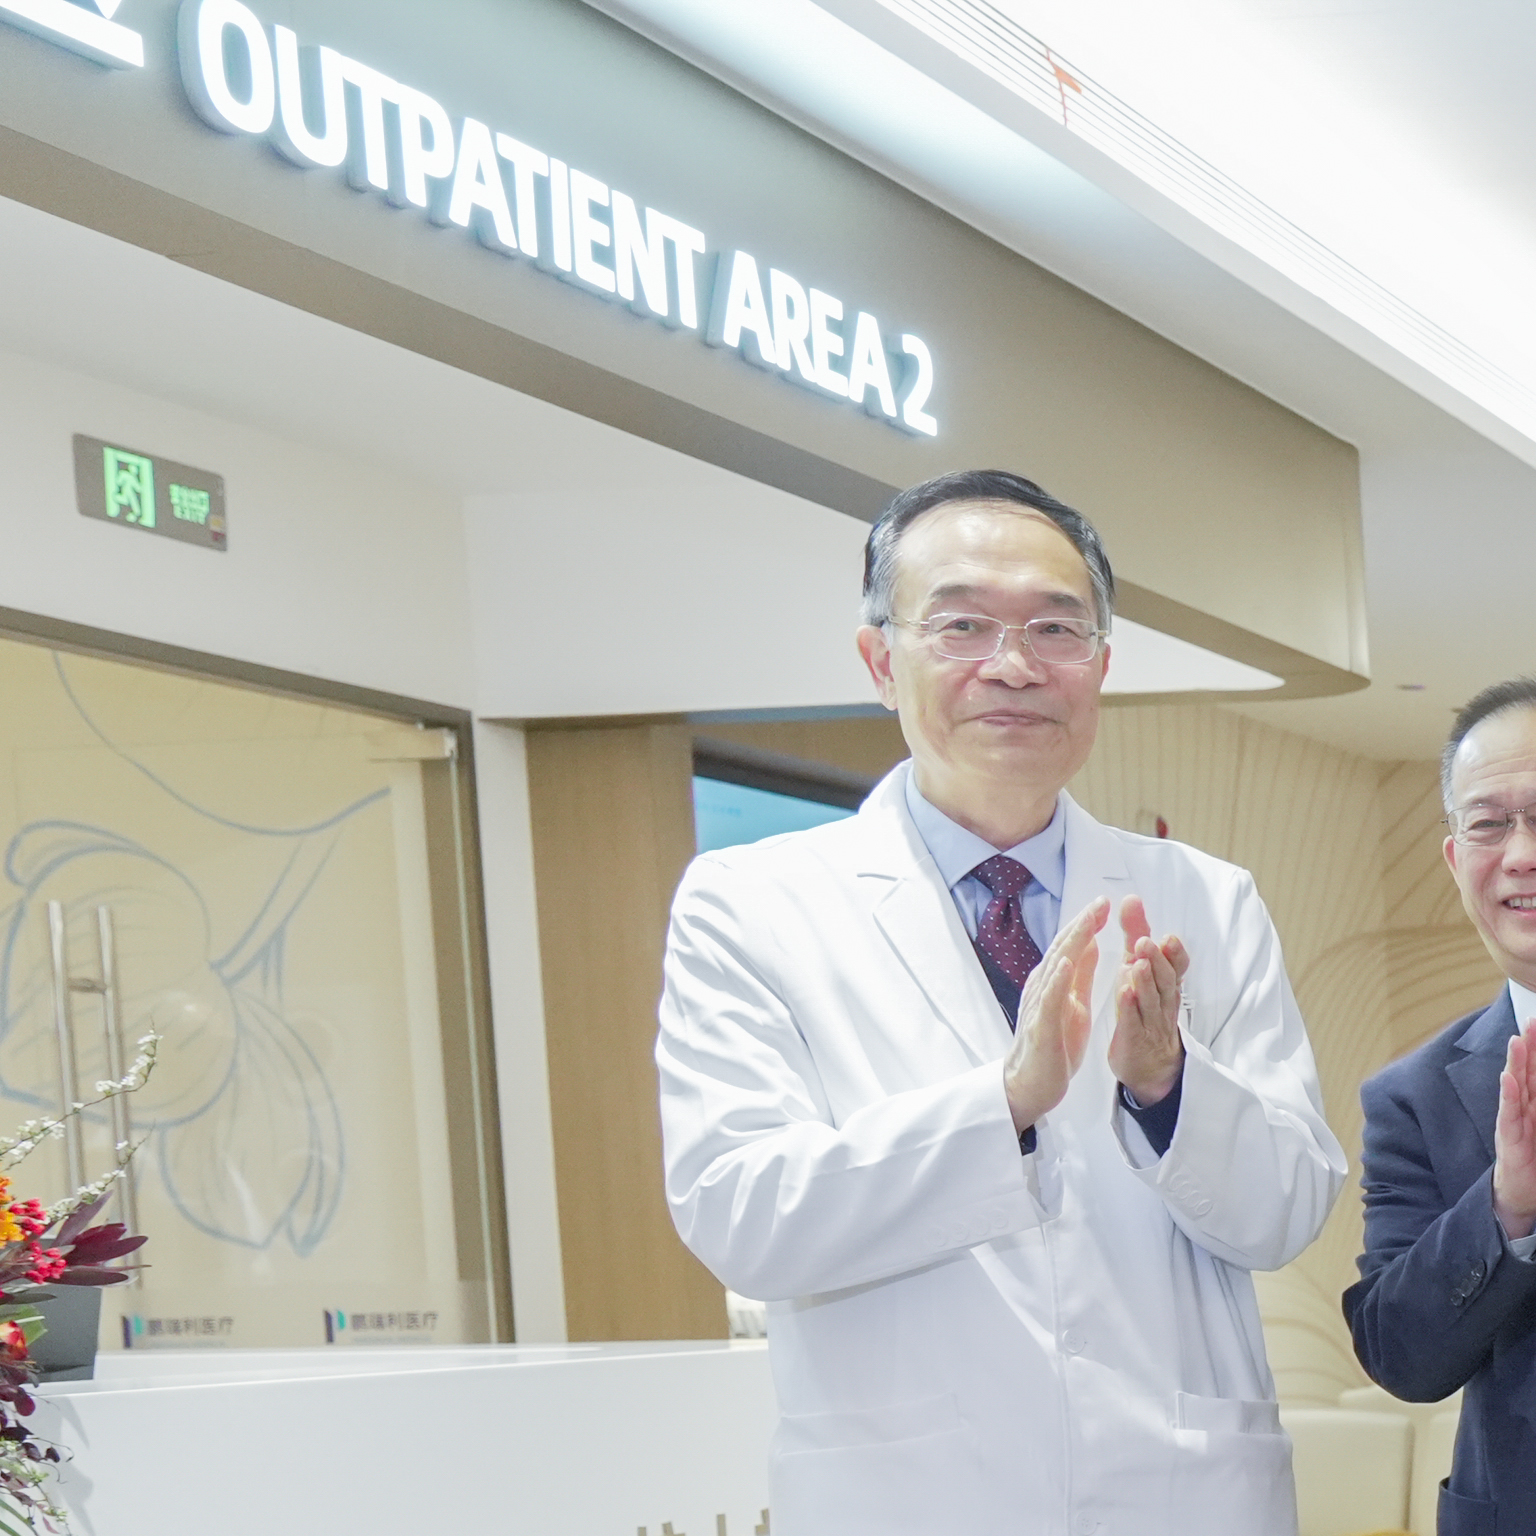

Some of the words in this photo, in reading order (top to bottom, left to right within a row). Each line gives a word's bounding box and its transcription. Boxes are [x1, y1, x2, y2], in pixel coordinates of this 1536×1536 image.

[186, 0, 706, 330] OUTPATIENT
[714, 250, 897, 418] AREA
[899, 334, 938, 437] 2
